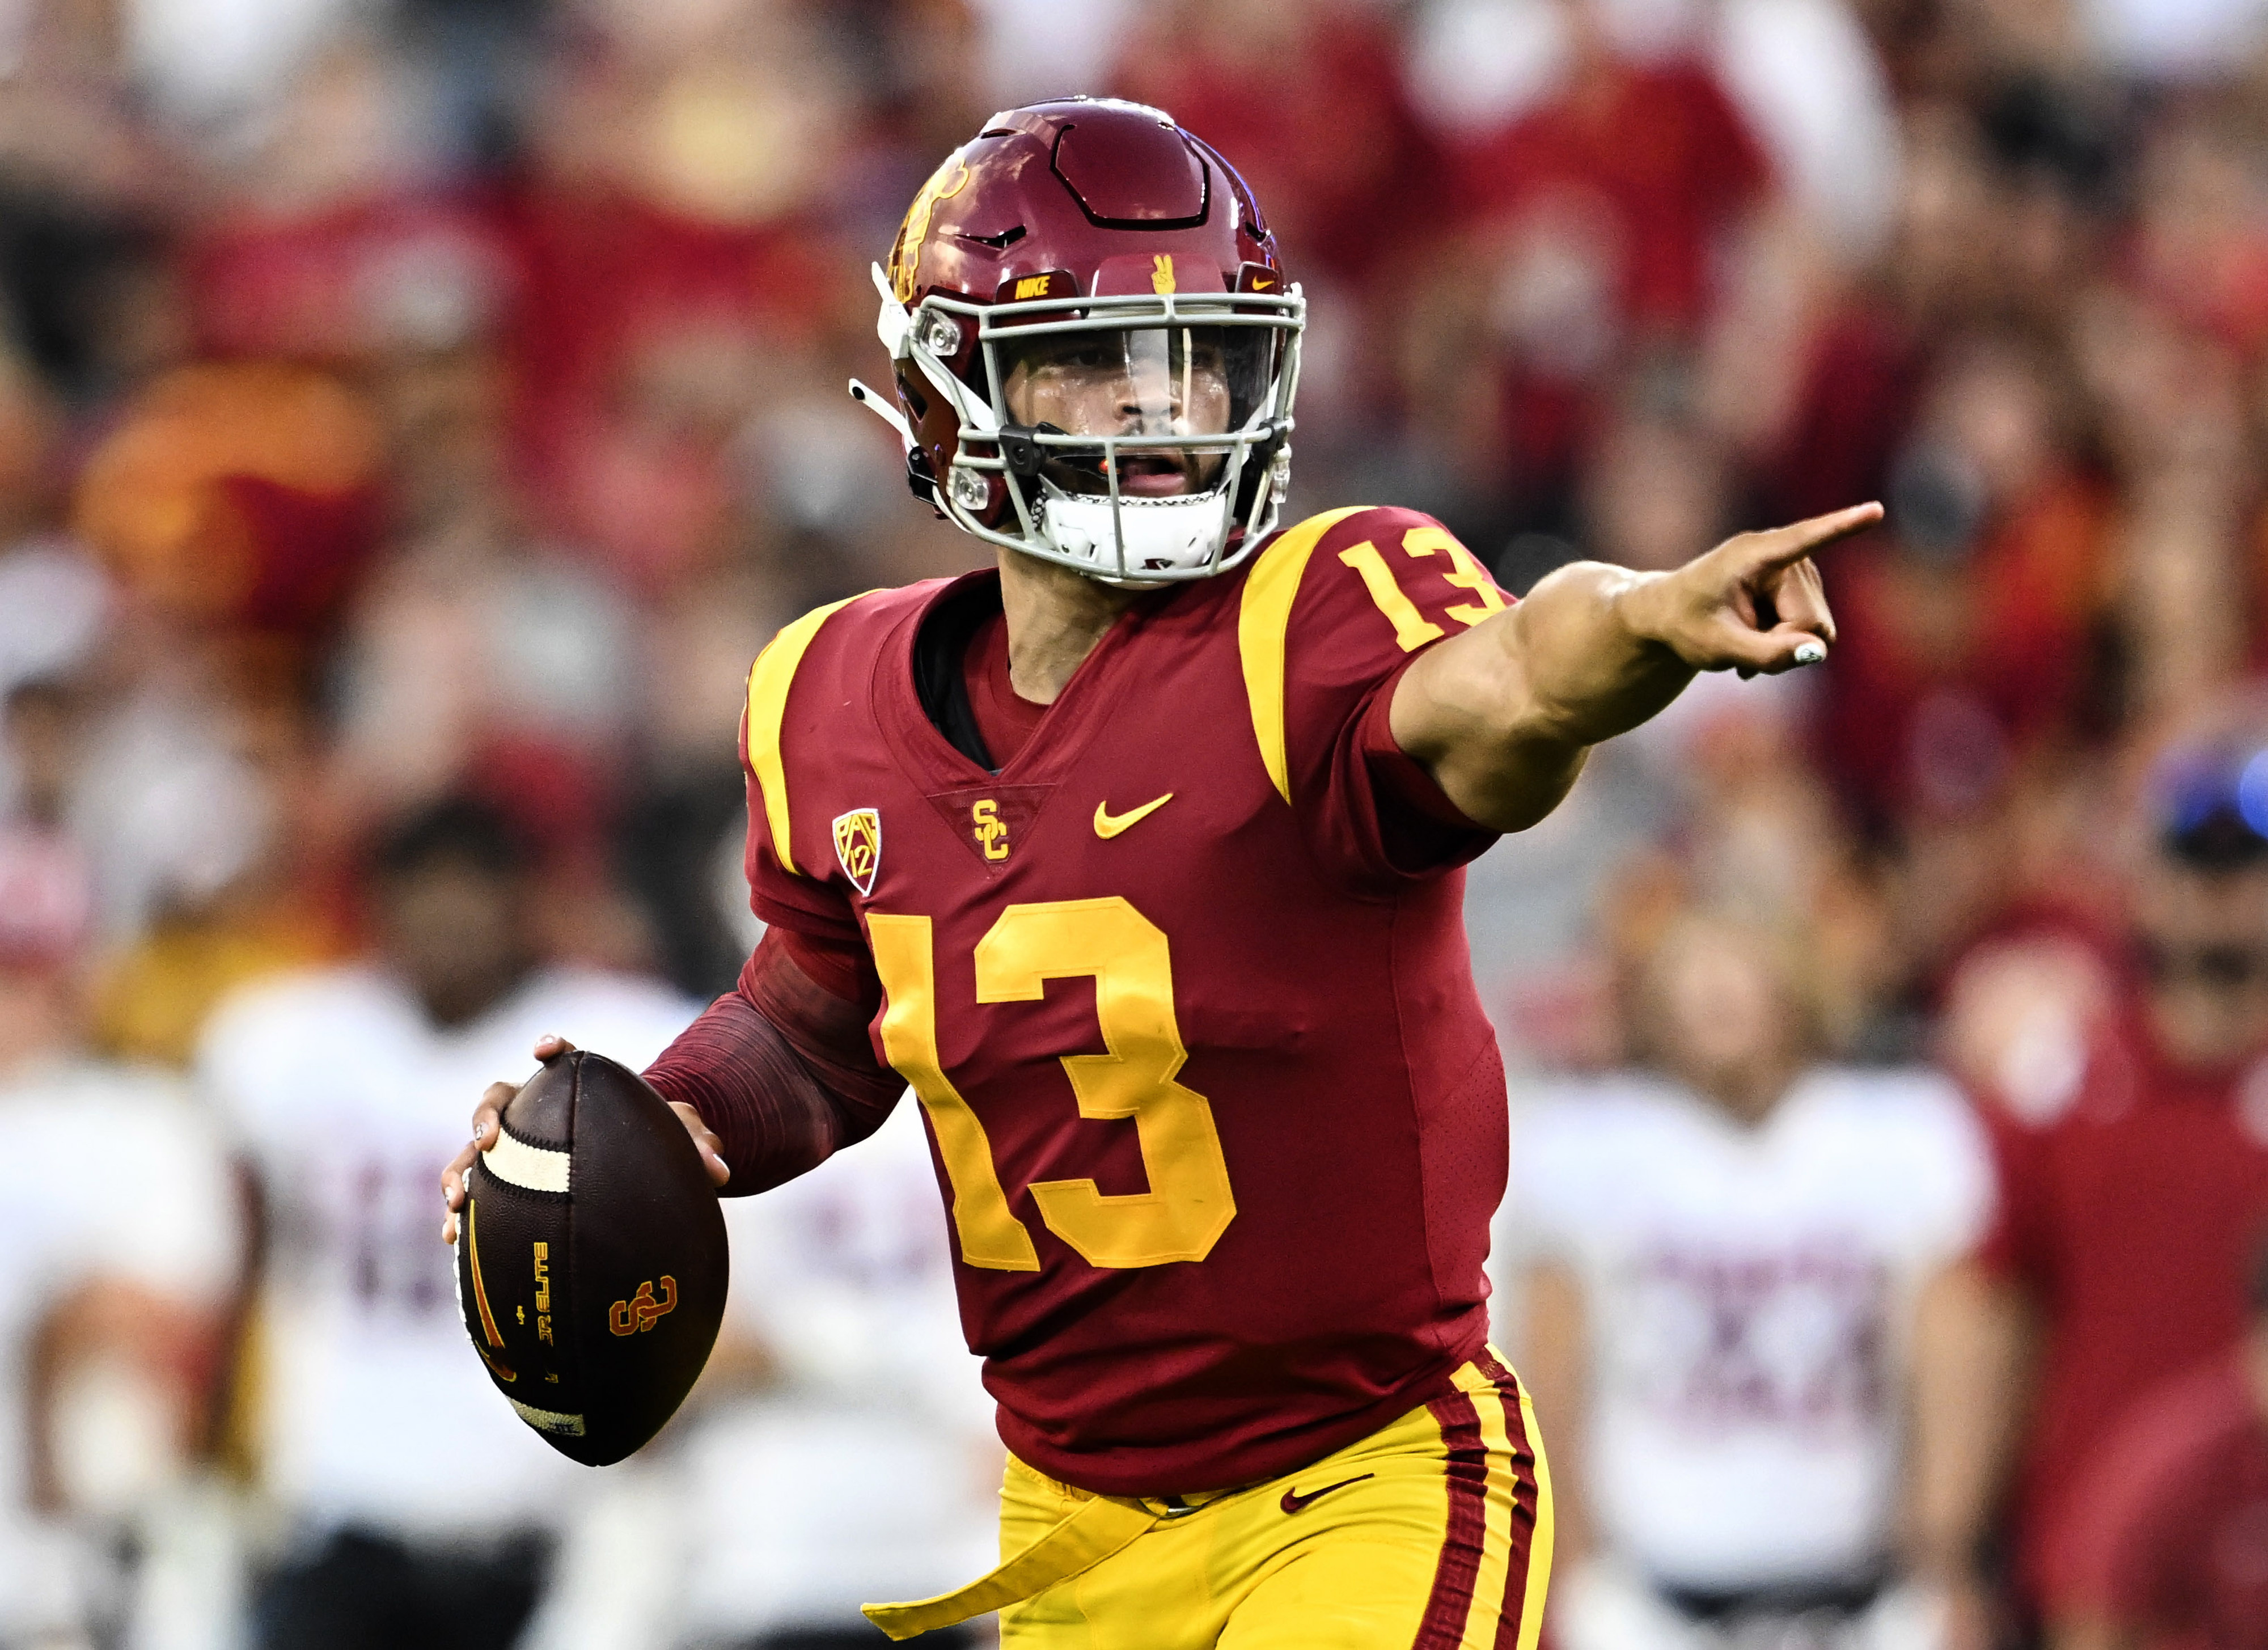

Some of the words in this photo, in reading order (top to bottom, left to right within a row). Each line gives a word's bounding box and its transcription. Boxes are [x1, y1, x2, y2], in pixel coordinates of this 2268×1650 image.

[1015, 276, 1051, 299] NIKE
[1338, 527, 1506, 653] 13
[835, 813, 877, 866] PAC
[972, 799, 1009, 860] SC
[850, 845, 873, 878] 12
[865, 896, 1237, 1272] 13
[534, 1242, 550, 1313] ELITE
[609, 1275, 678, 1336] SC
